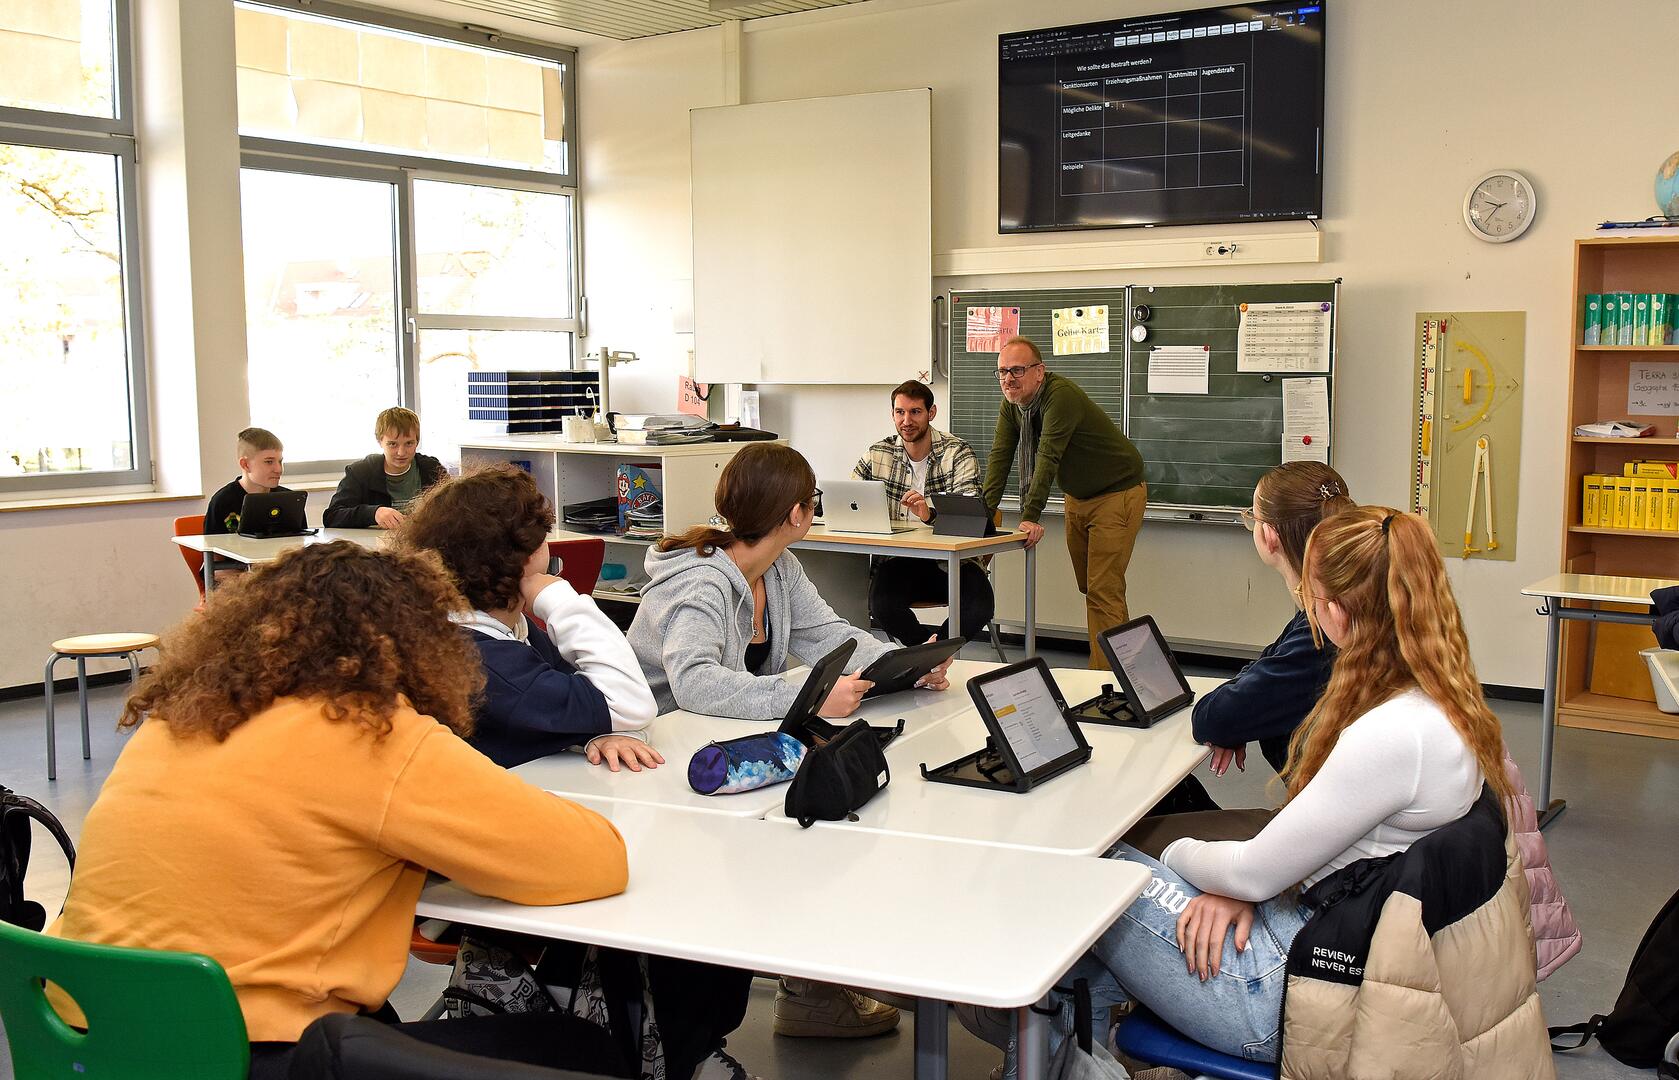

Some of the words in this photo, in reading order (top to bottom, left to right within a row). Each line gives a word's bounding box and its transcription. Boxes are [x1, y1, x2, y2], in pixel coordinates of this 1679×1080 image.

[1111, 60, 1129, 68] Bestraft
[1130, 58, 1152, 66] werden?
[1063, 81, 1098, 89] Sanktionsarten
[1105, 74, 1163, 85] Erziehungsmaßnahmen
[1168, 70, 1198, 79] Zuchtmittel
[1201, 66, 1235, 76] Jugendstrafe
[685, 393, 689, 401] D
[1313, 947, 1355, 963] REVIEW
[1311, 958, 1345, 973] NEVER
